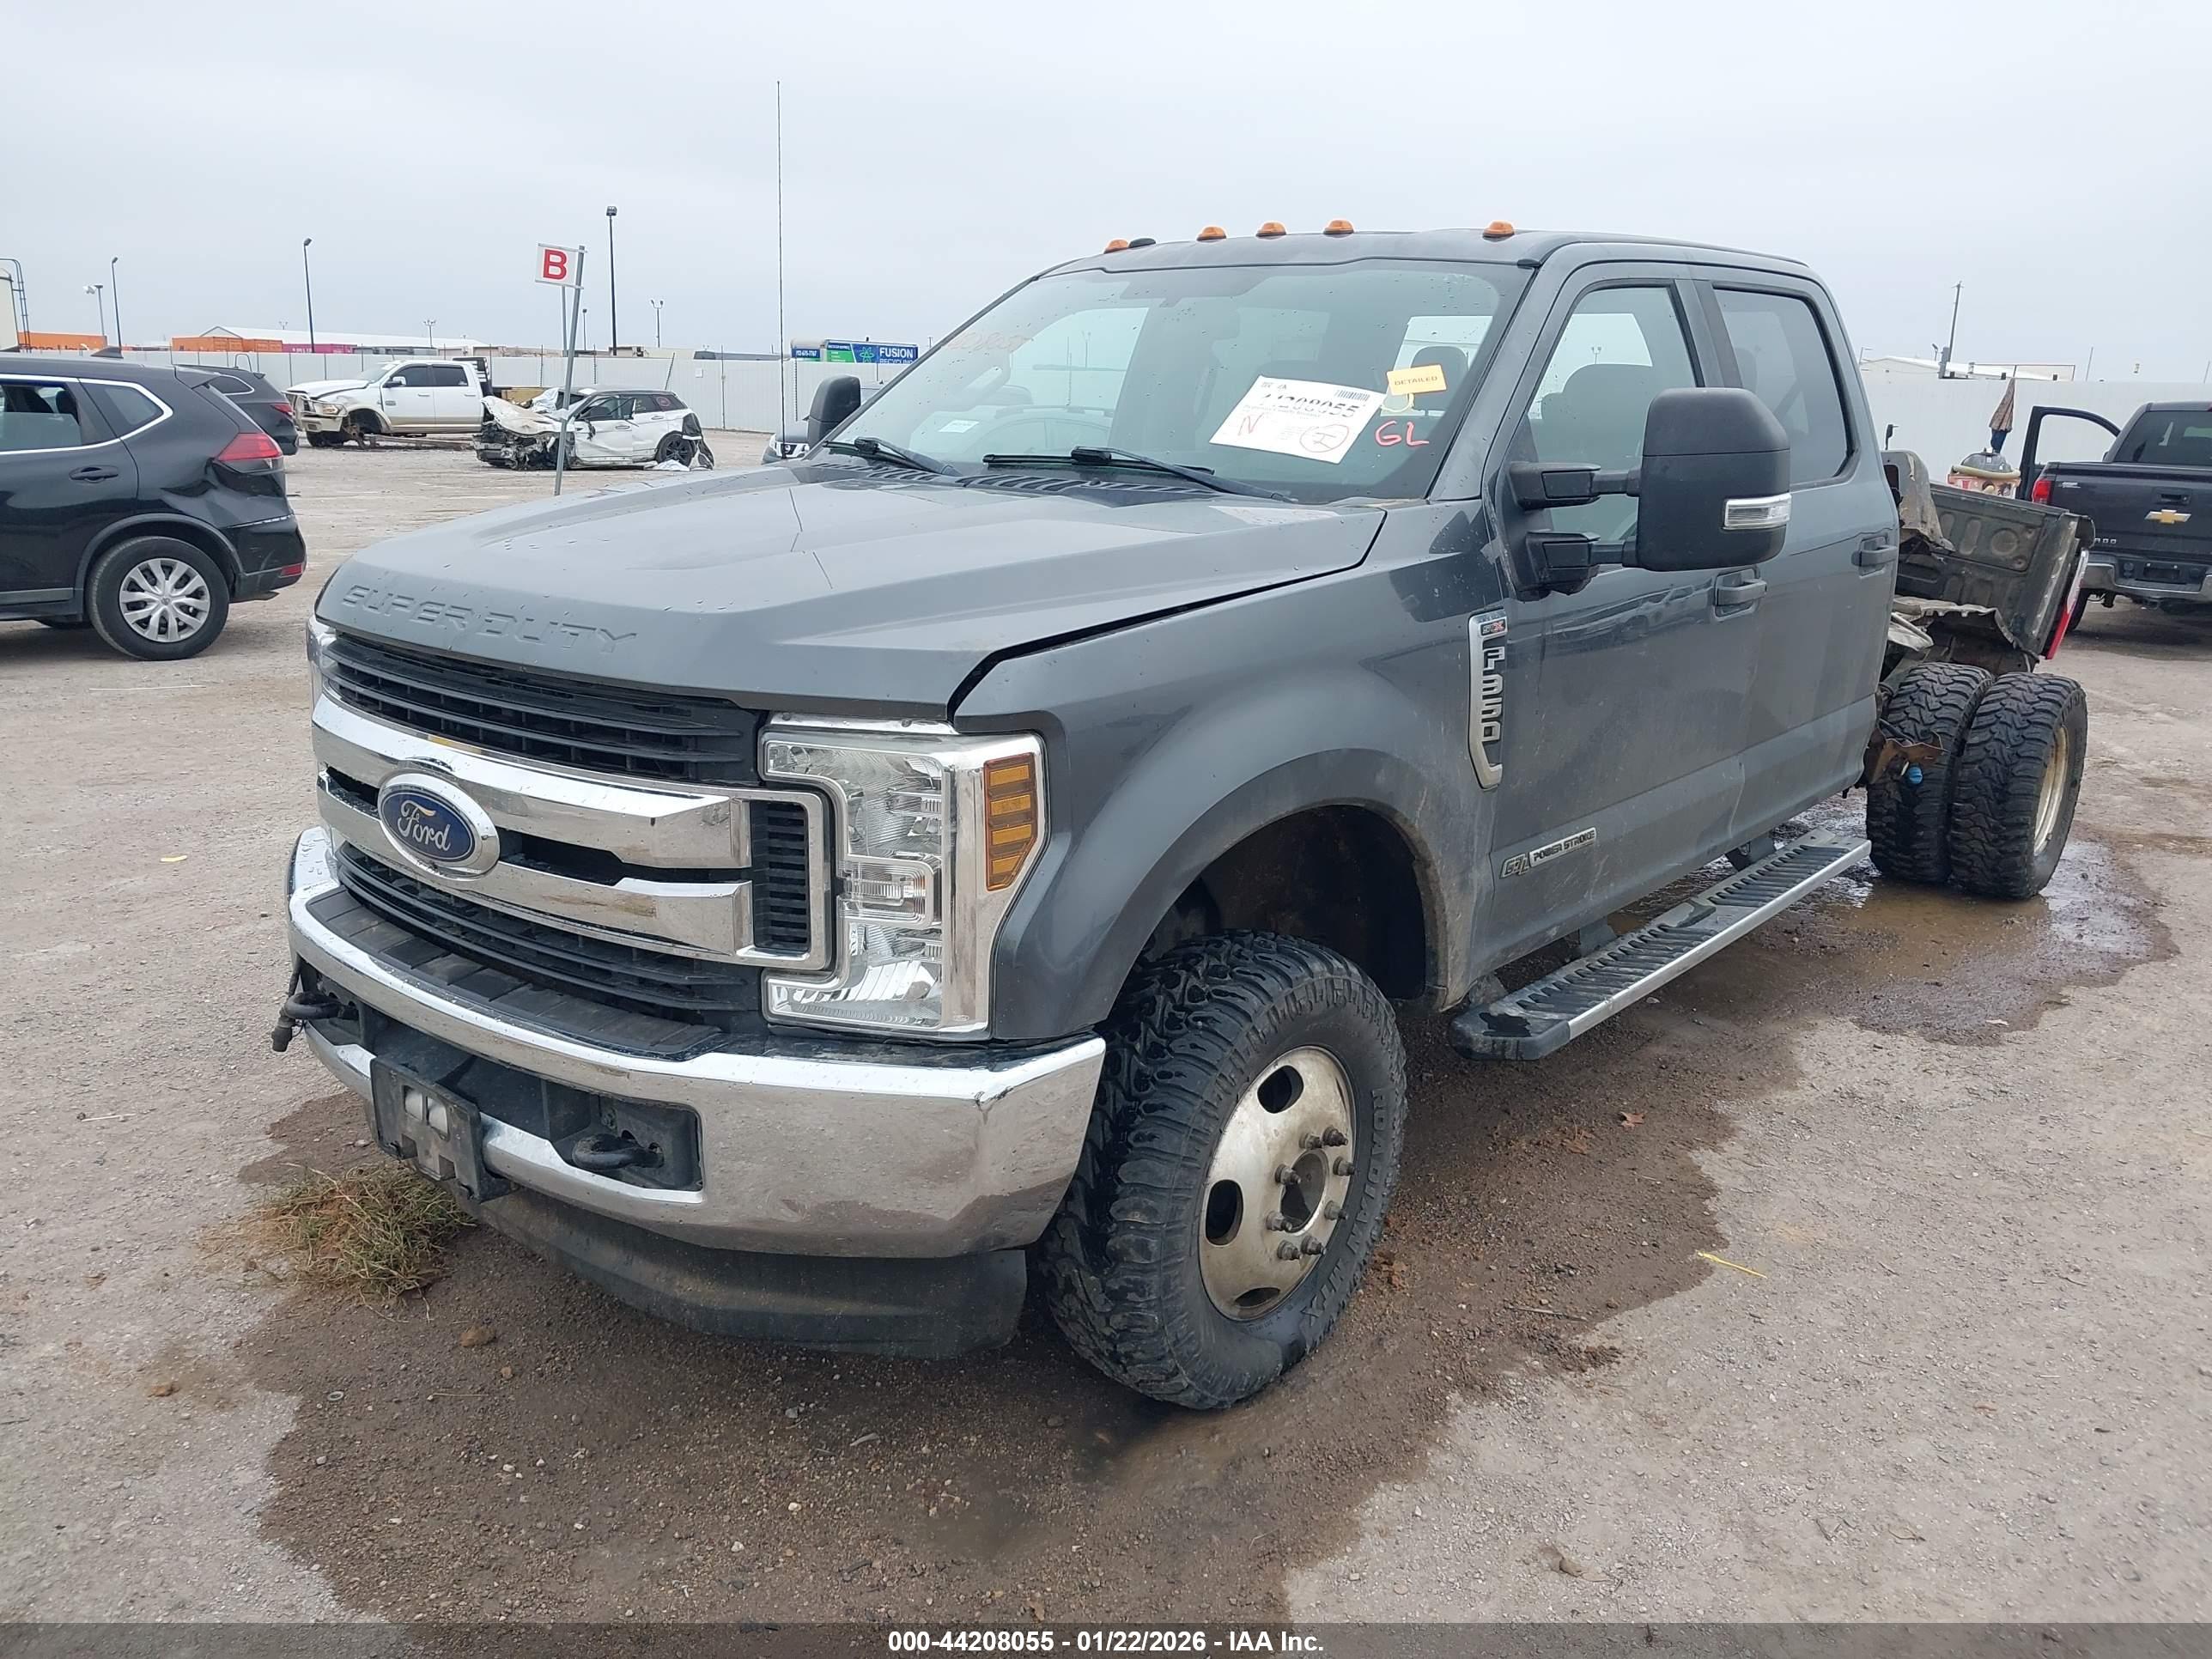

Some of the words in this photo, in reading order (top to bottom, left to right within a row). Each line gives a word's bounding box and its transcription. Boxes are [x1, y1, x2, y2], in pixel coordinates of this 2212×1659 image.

[543, 248, 568, 280] B
[879, 347, 914, 359] FUSION
[1394, 375, 1438, 386] DETAILED
[1375, 420, 1430, 446] GL
[343, 584, 474, 630] SUPER
[476, 611, 637, 653] DUTY
[397, 799, 452, 852] Ford
[1533, 844, 1562, 861] POWER
[1564, 830, 1595, 849] STROKE
